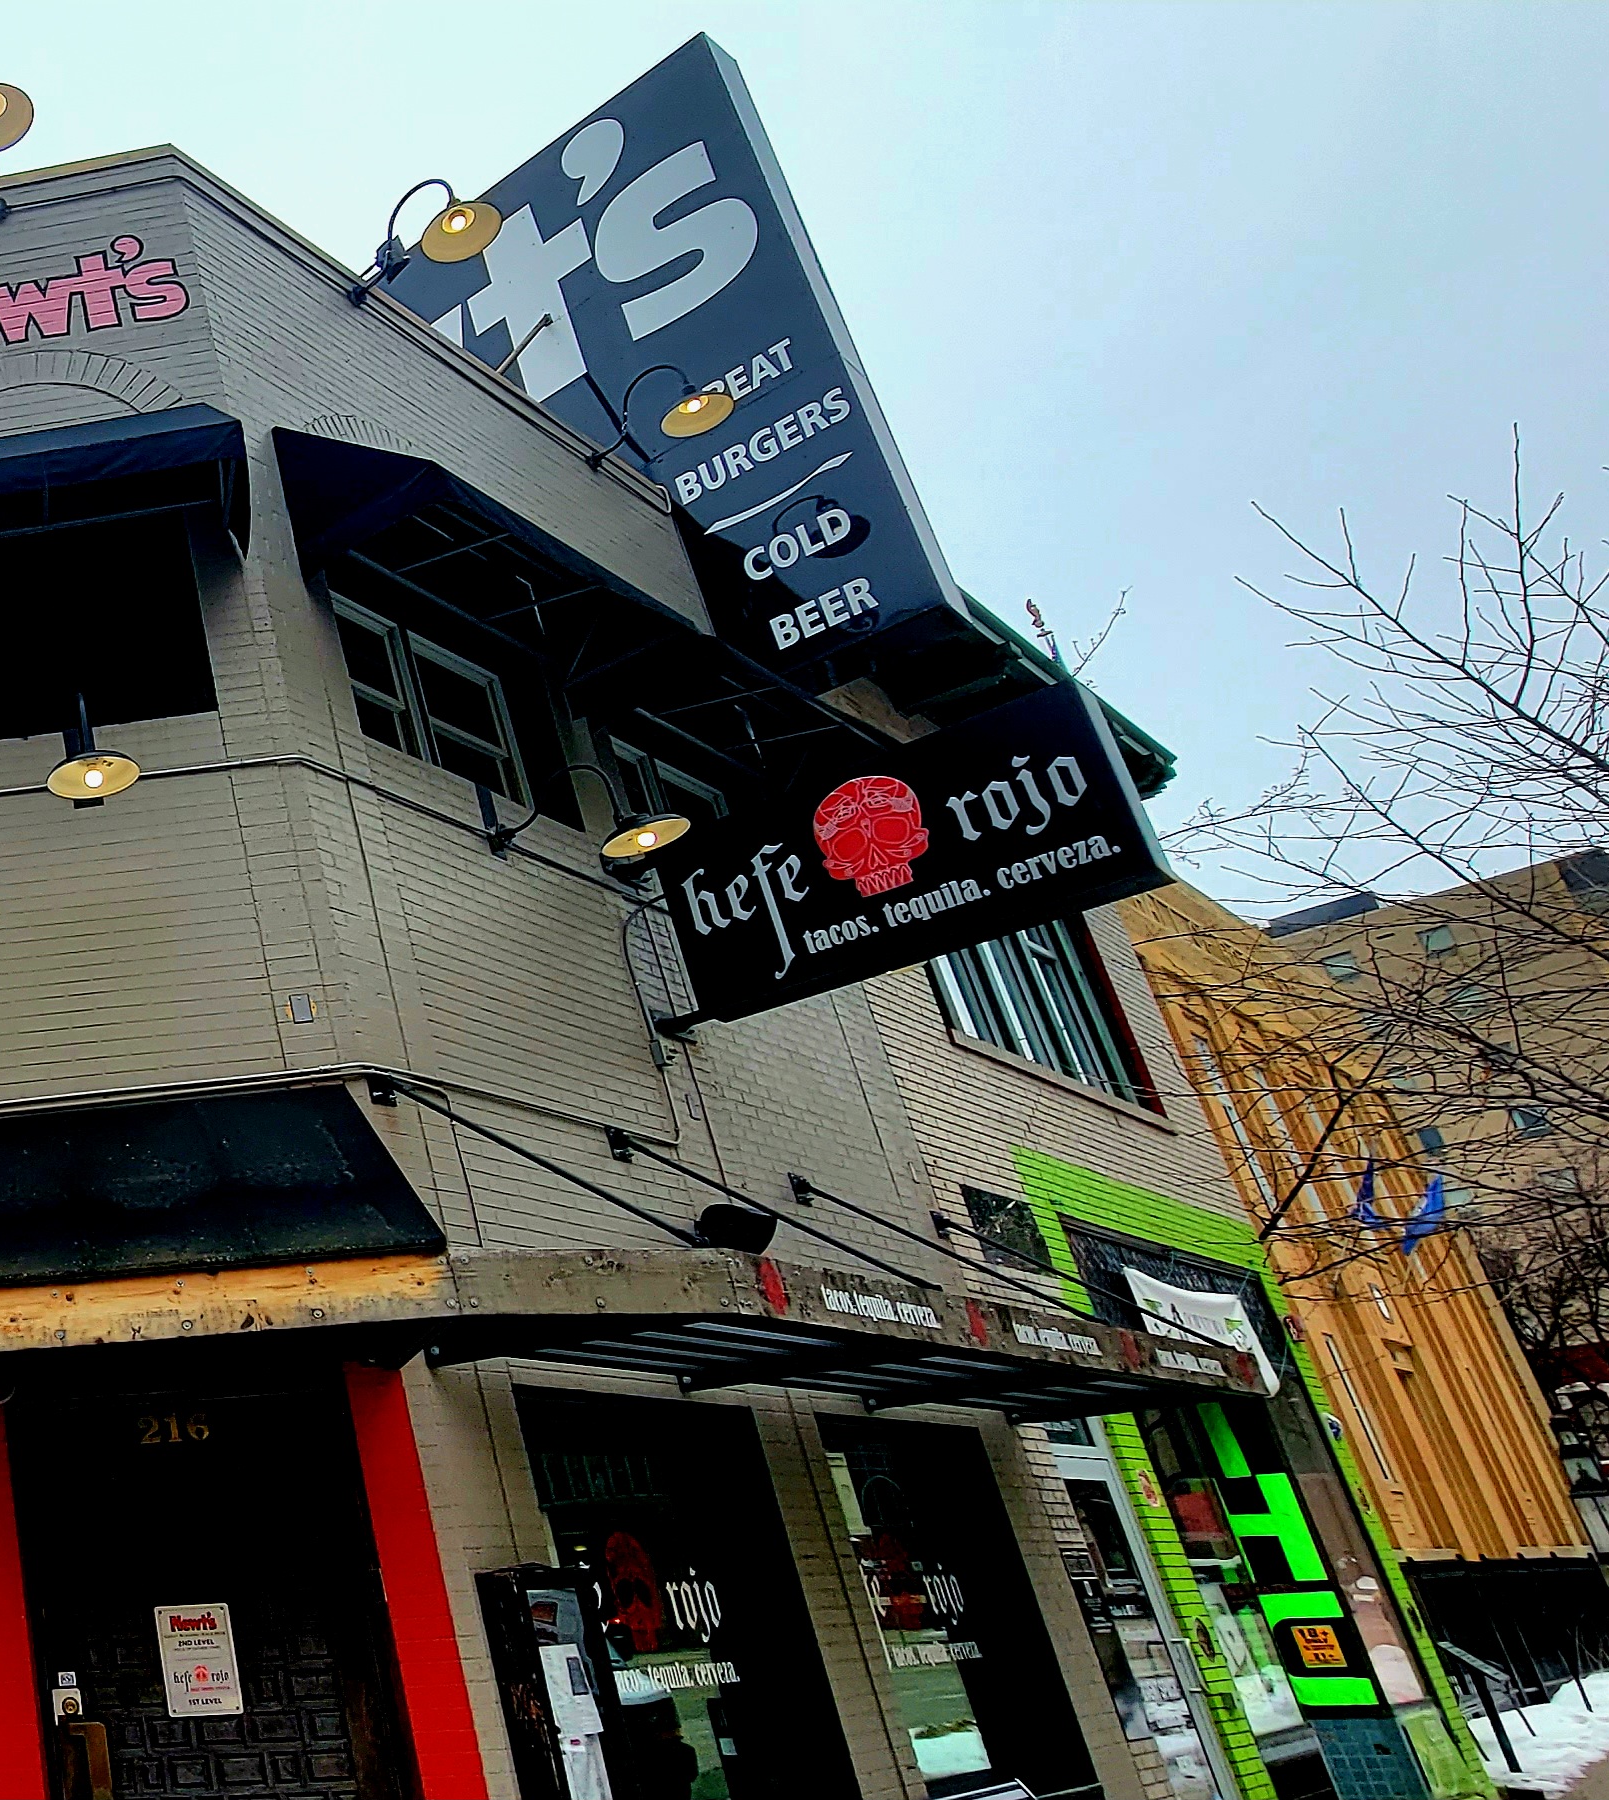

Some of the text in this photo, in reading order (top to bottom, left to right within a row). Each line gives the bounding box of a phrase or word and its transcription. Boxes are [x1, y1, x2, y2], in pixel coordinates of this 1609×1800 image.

[430, 117, 759, 402] t's
[702, 337, 793, 402] EAT
[675, 387, 851, 506] BURGERS
[744, 508, 851, 581] COLD
[769, 577, 879, 650] BEER
[681, 756, 1087, 979] hefe rojo
[803, 835, 1121, 954] tacos. tequila. cerveza.
[138, 1413, 209, 1444] 216
[169, 1611, 217, 1632] Newt's
[666, 1566, 721, 1642] rojo
[923, 1563, 964, 1625] rojo
[647, 1662, 694, 1693] tequila.
[695, 1661, 740, 1686] cerveza.
